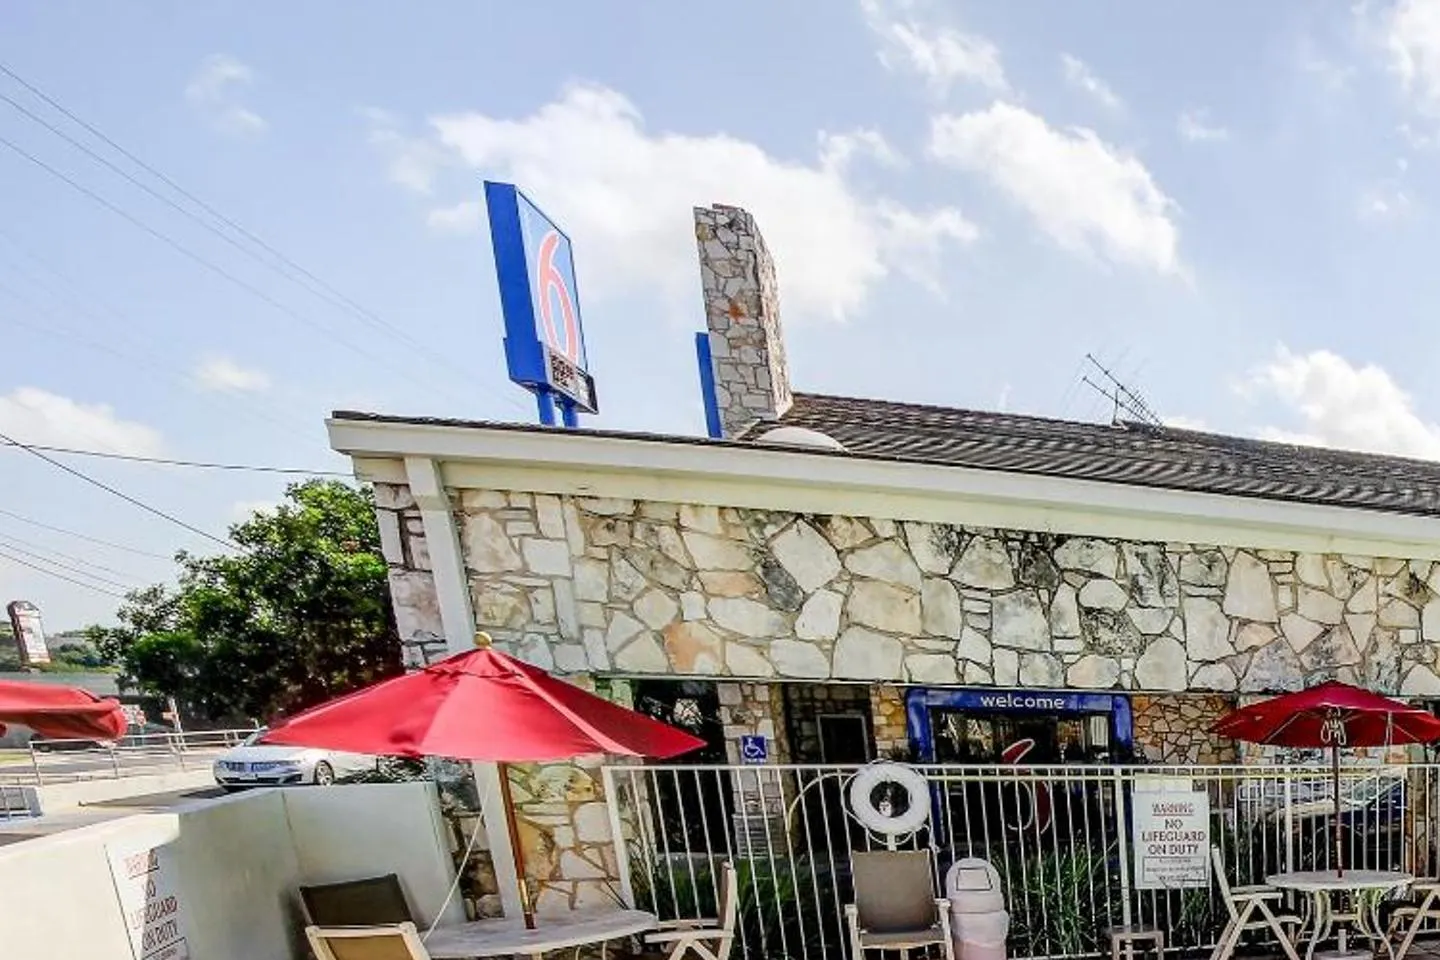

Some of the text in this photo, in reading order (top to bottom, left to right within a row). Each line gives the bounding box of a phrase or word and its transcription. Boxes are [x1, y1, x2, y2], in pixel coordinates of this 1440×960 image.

[538, 230, 578, 364] 6
[980, 693, 1065, 709] welcome
[1152, 803, 1194, 813] WARNING
[1165, 819, 1184, 830] NO
[1142, 831, 1206, 841] LIFEGUARD
[1148, 844, 1199, 855] ON DUTY
